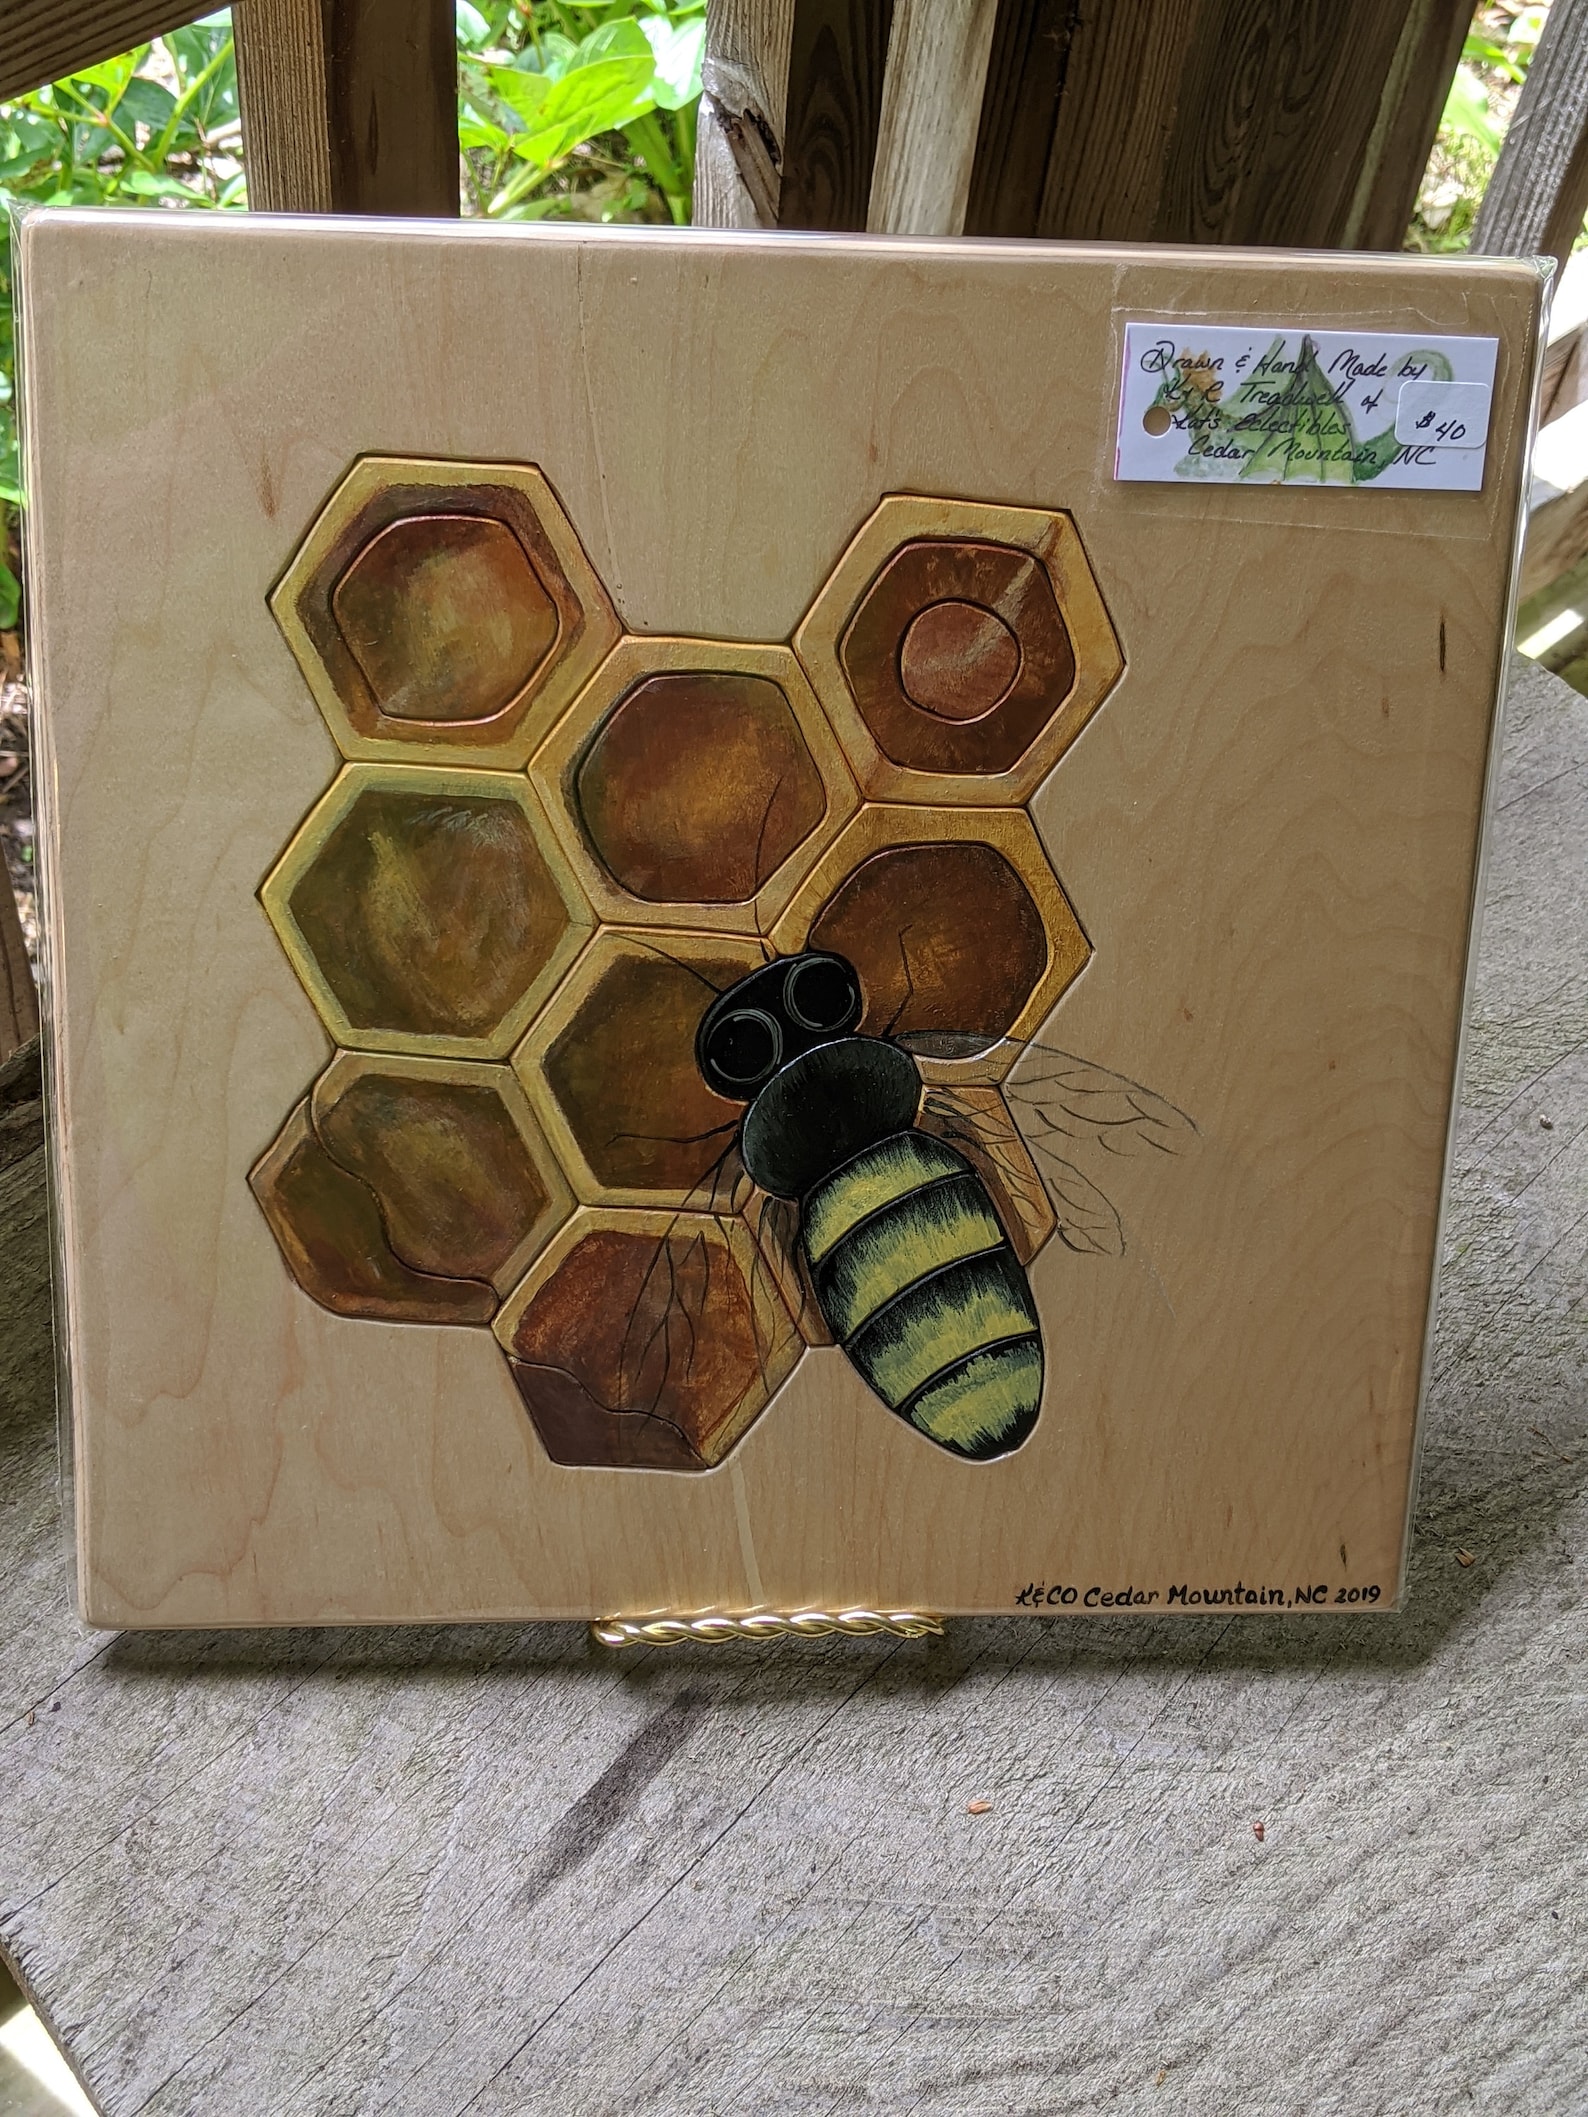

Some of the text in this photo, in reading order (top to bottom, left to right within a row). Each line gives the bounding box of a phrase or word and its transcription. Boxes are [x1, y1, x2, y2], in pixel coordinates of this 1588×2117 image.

[1140, 340, 1225, 373] Drawn
[1252, 340, 1319, 377] Hand
[1327, 348, 1388, 380] Made
[1397, 356, 1428, 381] by
[1360, 388, 1384, 415] of
[1187, 434, 1255, 459] Cedar
[1392, 445, 1437, 465] NC
[1083, 1585, 1159, 1607] Cedar
[1334, 1584, 1381, 1604] 2019
